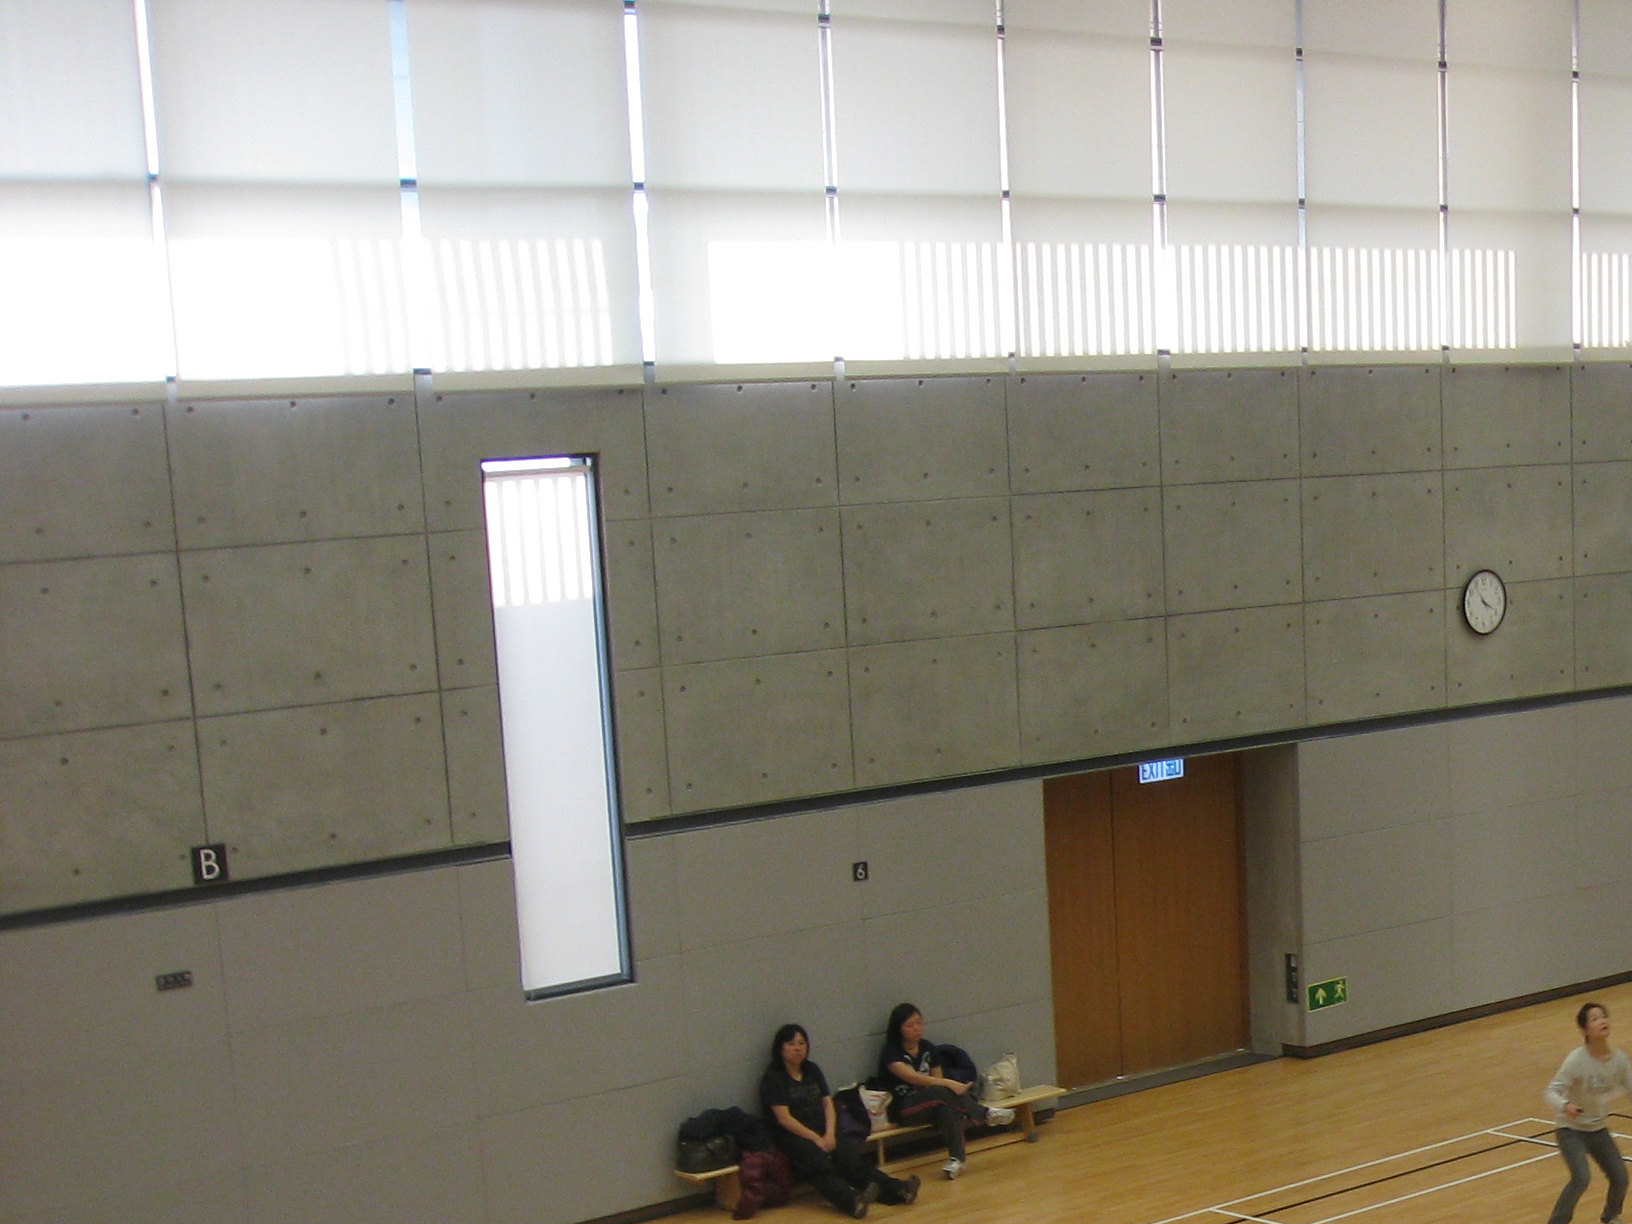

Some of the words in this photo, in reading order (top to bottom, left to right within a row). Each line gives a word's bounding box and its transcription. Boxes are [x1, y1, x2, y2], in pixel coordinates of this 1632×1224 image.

[1142, 761, 1164, 780] EXIT
[200, 849, 220, 880] B
[856, 863, 865, 879] 6
